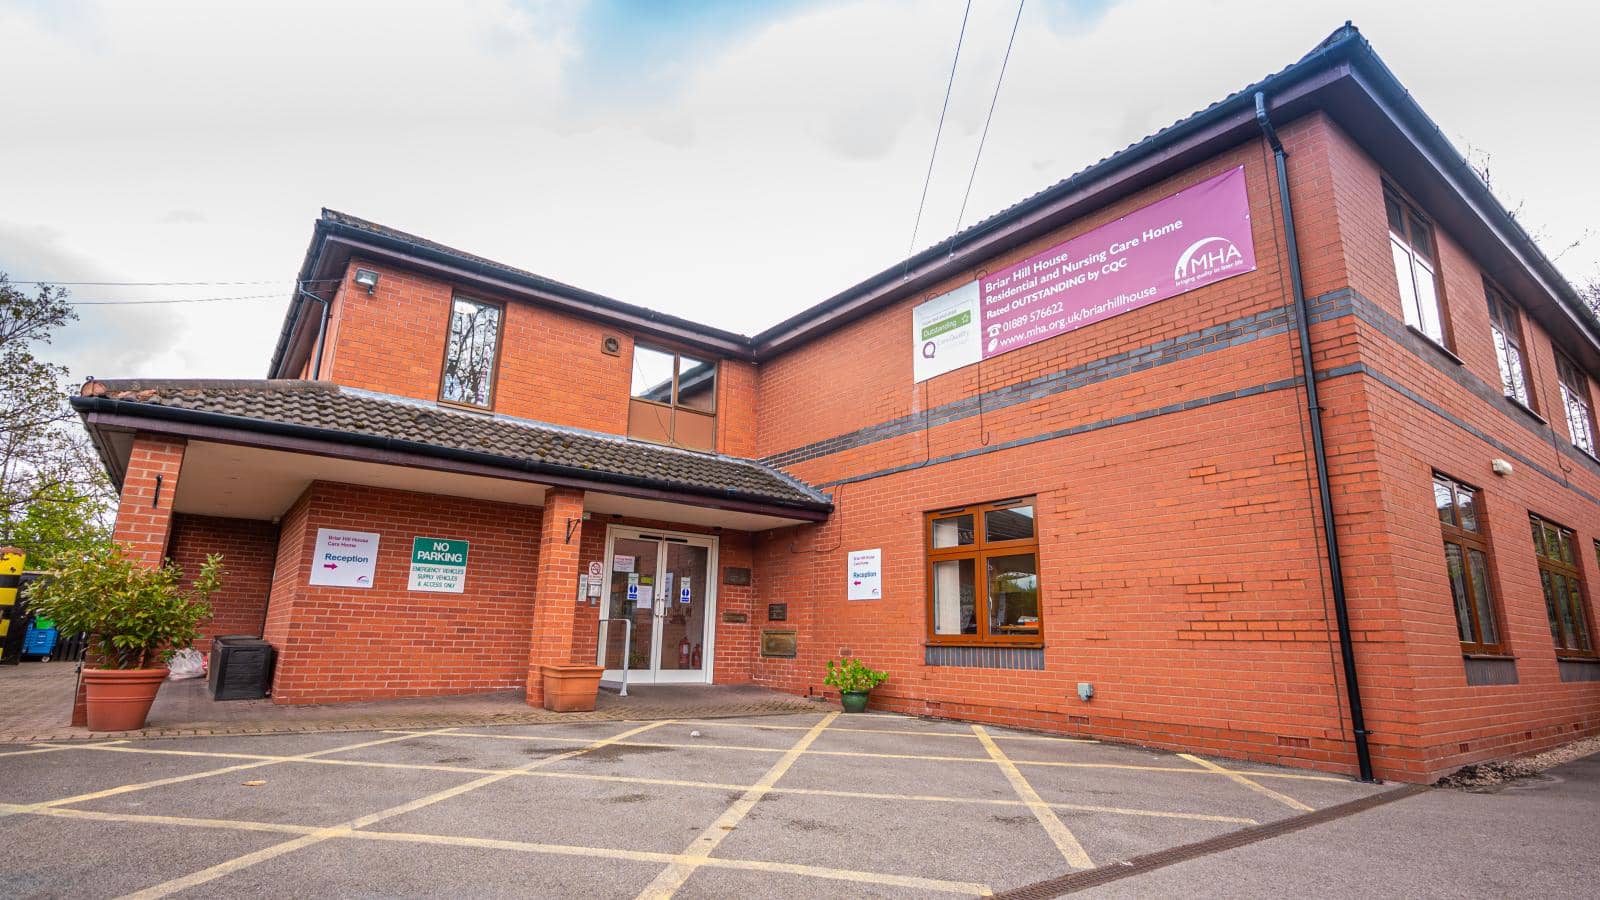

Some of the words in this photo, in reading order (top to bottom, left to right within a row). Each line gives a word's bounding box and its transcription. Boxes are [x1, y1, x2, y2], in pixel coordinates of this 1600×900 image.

[985, 277, 1038, 305] Residential
[1040, 268, 1060, 284] and
[1062, 250, 1107, 275] Nursing
[1109, 238, 1139, 255] Care
[1142, 220, 1183, 243] Home
[985, 278, 1011, 293] Briar
[1012, 265, 1031, 281] Hill
[1033, 253, 1068, 273] House
[1191, 244, 1242, 274] MHA
[986, 303, 1010, 319] Rated
[1011, 274, 1086, 309] OUTSTANDING
[1087, 270, 1099, 281] by
[1101, 257, 1128, 275] CQC
[923, 320, 957, 337] Outstanding
[1000, 286, 1157, 346] www.mha.org.uk/briarhillhouse
[1002, 315, 1028, 332] 01889
[1029, 301, 1064, 322] 576622
[325, 553, 369, 563] Reception
[417, 551, 463, 562] PARKING
[433, 542, 450, 551] NO
